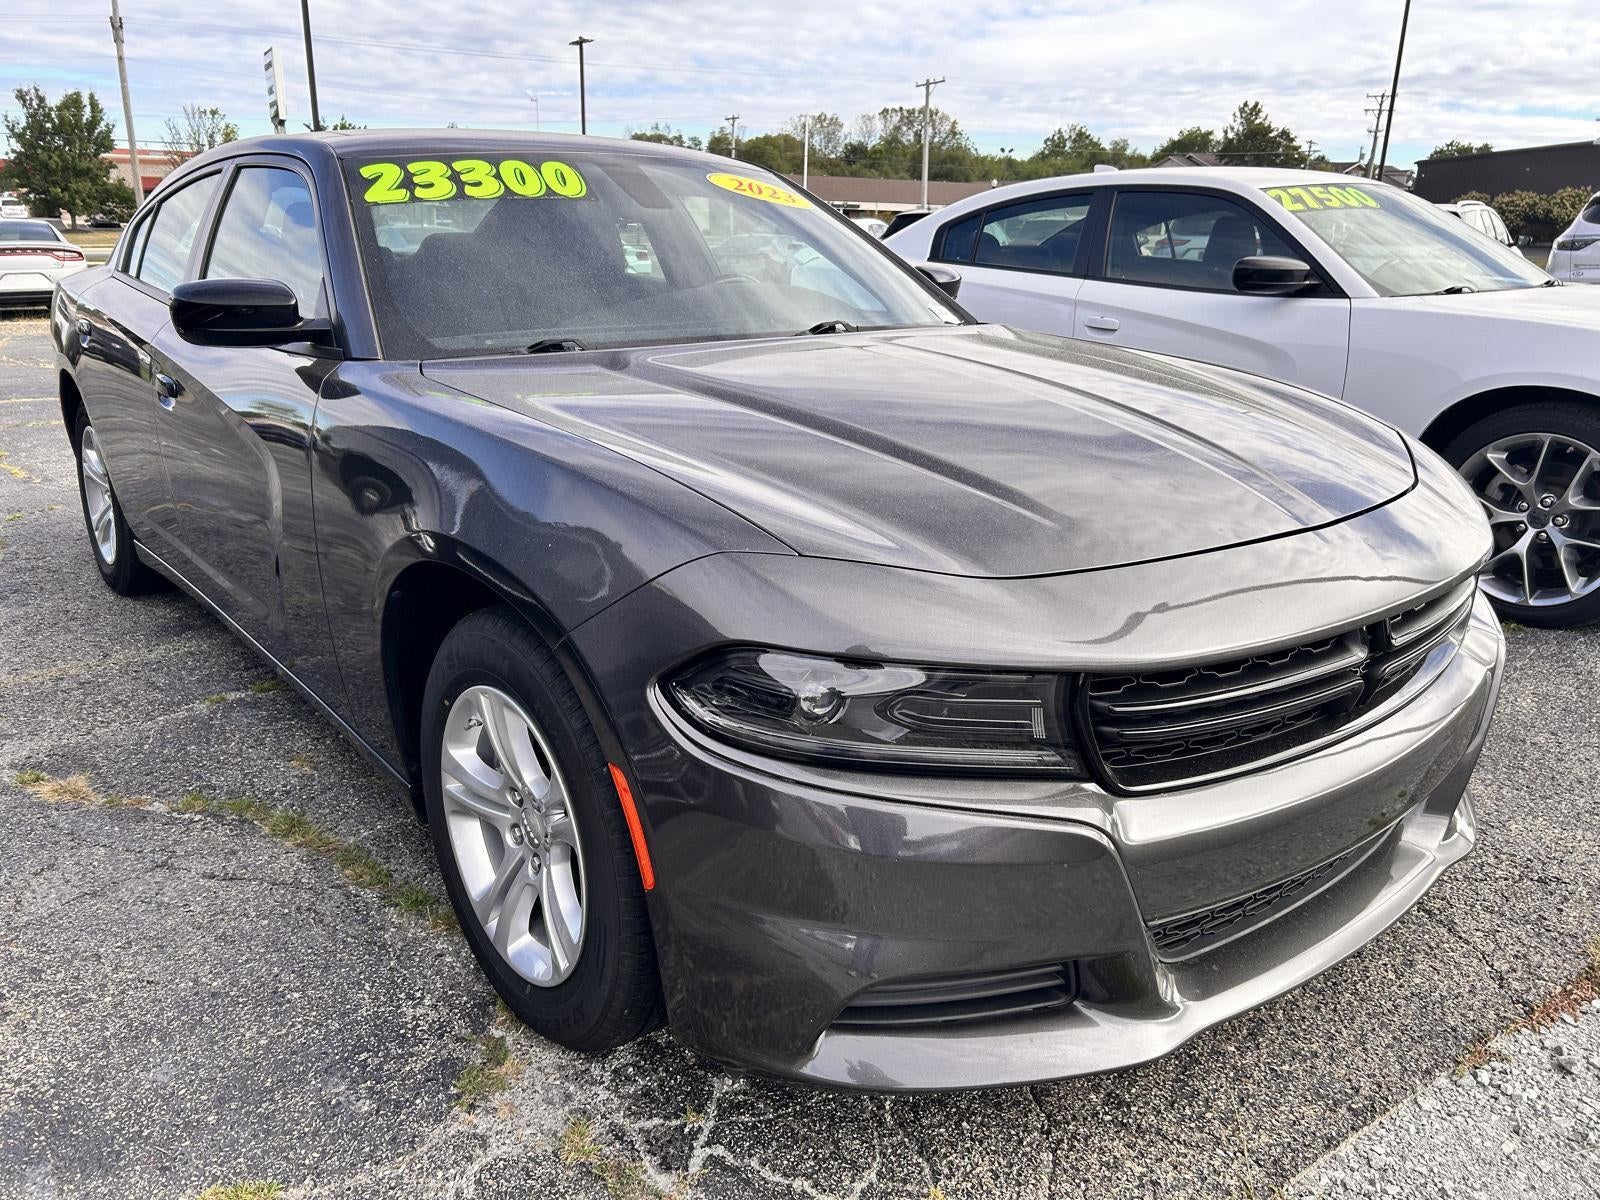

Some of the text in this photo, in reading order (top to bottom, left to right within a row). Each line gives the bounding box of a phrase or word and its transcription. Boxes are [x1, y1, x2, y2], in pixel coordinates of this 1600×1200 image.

[359, 159, 587, 204] 23300
[730, 178, 796, 204] 2023
[1266, 186, 1381, 211] 27500
